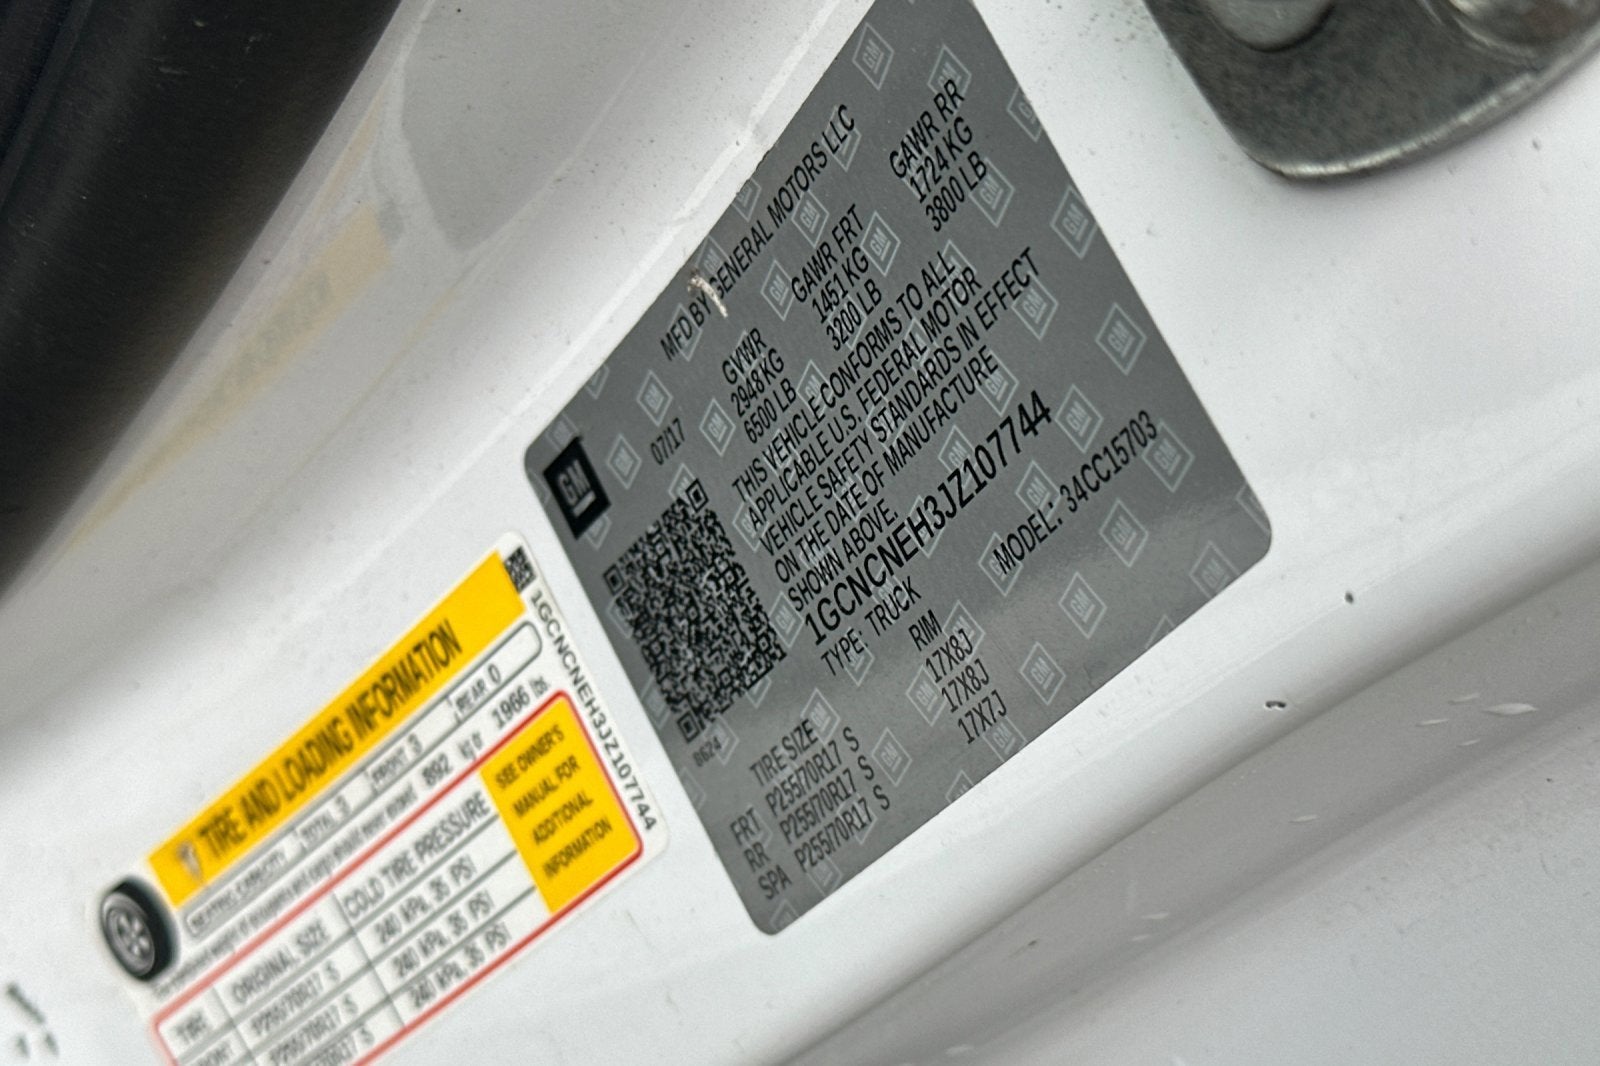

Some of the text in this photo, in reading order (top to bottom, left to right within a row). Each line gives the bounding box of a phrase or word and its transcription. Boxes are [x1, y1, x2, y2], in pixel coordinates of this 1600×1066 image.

[885, 79, 963, 182] GAWR RR
[907, 112, 976, 204] 1724 KG
[659, 104, 853, 363] MFD BY GENERAL MOTORS LLC
[923, 151, 986, 234] 3800 LB
[788, 201, 867, 306] GAWR FRT
[812, 246, 868, 323] 1451 KG
[826, 274, 884, 350] 3200 LB
[719, 324, 768, 389] GVWR
[731, 348, 783, 416] 2948 KG
[732, 244, 957, 501] THIS VEHICLE CONFORMS TO ALL
[744, 262, 984, 531] APPLICABLE U.S. FEDERAL MOTOR
[648, 414, 688, 468] 07/17
[744, 378, 795, 443] 6500 LB
[759, 245, 1044, 555] VEHICLE SAFETY STANDARDS IN EFFECT
[772, 342, 1002, 587] ON THE DATE OF MANUFACTURE
[991, 407, 1162, 575] MODEL: 34CC15703
[788, 493, 899, 611] SHOWN ABOVE.
[800, 386, 1058, 647] 1GCNCNEH3JZ107744
[820, 576, 920, 679] TYPE: TRUCK
[908, 609, 941, 650] RIM
[926, 628, 972, 682] 17X8J
[454, 661, 503, 715] REAR 0
[531, 589, 657, 830] 1GCNCNEH3JZ107744
[941, 658, 988, 712] 17X8J
[958, 690, 1006, 743] 17X7J
[197, 617, 463, 862] TIRE AND LOADING INFORMATION
[420, 751, 453, 789] 892
[491, 684, 531, 730] 1966
[495, 723, 564, 790] SEE OWNER'S
[749, 719, 817, 785] TIRE SIZE
[512, 754, 580, 819] MANUAL FOR
[531, 788, 593, 846] ADDITIONAL
[730, 727, 858, 844] FRT P255/70R17 S
[744, 755, 873, 871] RR P255/70R17 S
[341, 789, 491, 920] COLD TIRE PRESSURE
[427, 873, 451, 904] 35
[447, 851, 477, 886] PSI
[542, 815, 612, 879] INFORMATION
[756, 785, 889, 902] SPA P255/70R17 S
[445, 907, 469, 938] 35
[466, 886, 495, 921] PSI
[461, 939, 486, 970] 35
[482, 918, 512, 954] PSI
